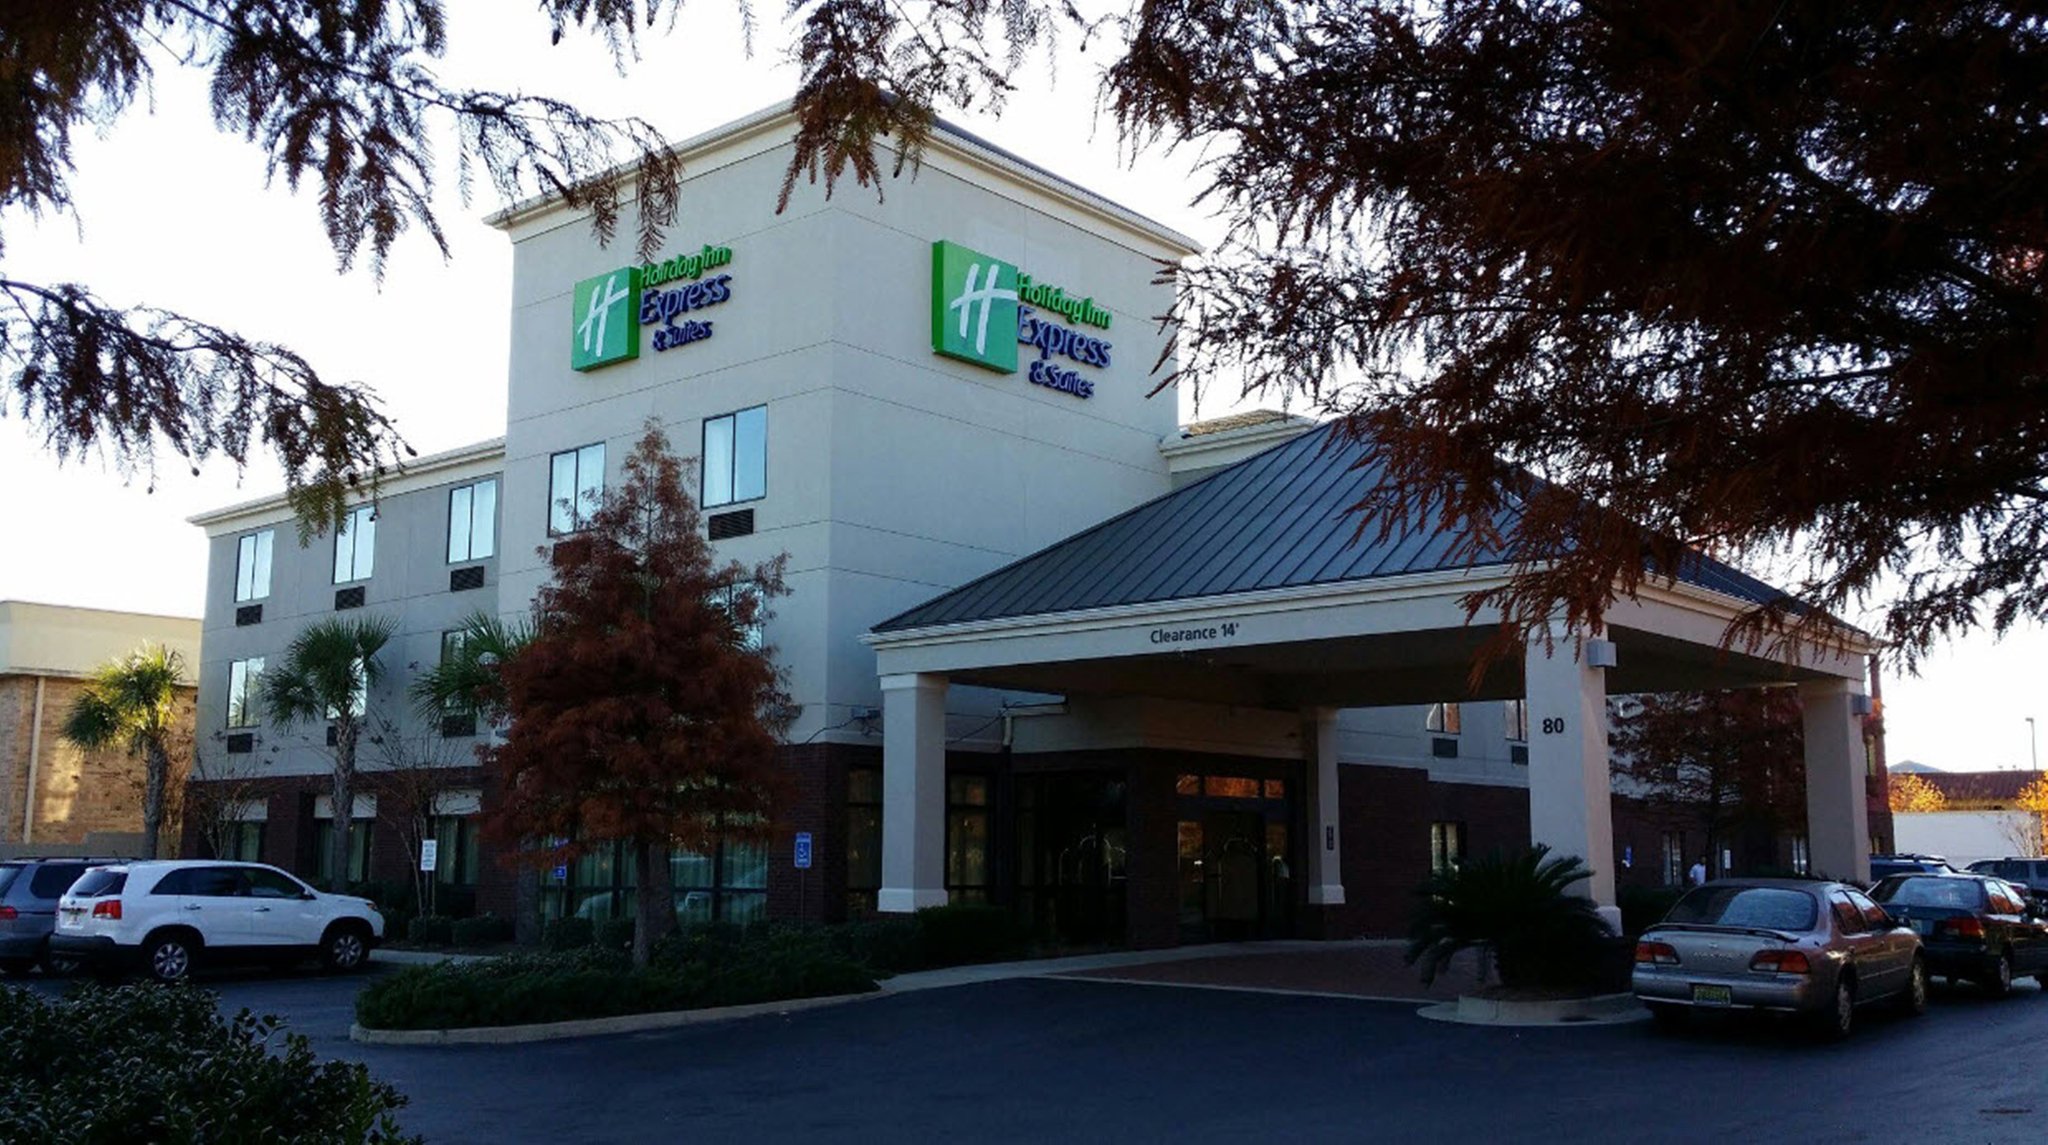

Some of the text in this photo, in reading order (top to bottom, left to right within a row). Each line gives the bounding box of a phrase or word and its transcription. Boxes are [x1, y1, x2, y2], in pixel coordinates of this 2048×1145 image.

[640, 244, 732, 288] Holiday Inn
[639, 274, 732, 325] Express
[1017, 272, 1112, 329] Holiday Inn
[1017, 305, 1112, 368] Express
[1150, 623, 1240, 644] Clearance 14'
[1543, 717, 1564, 734] 80
